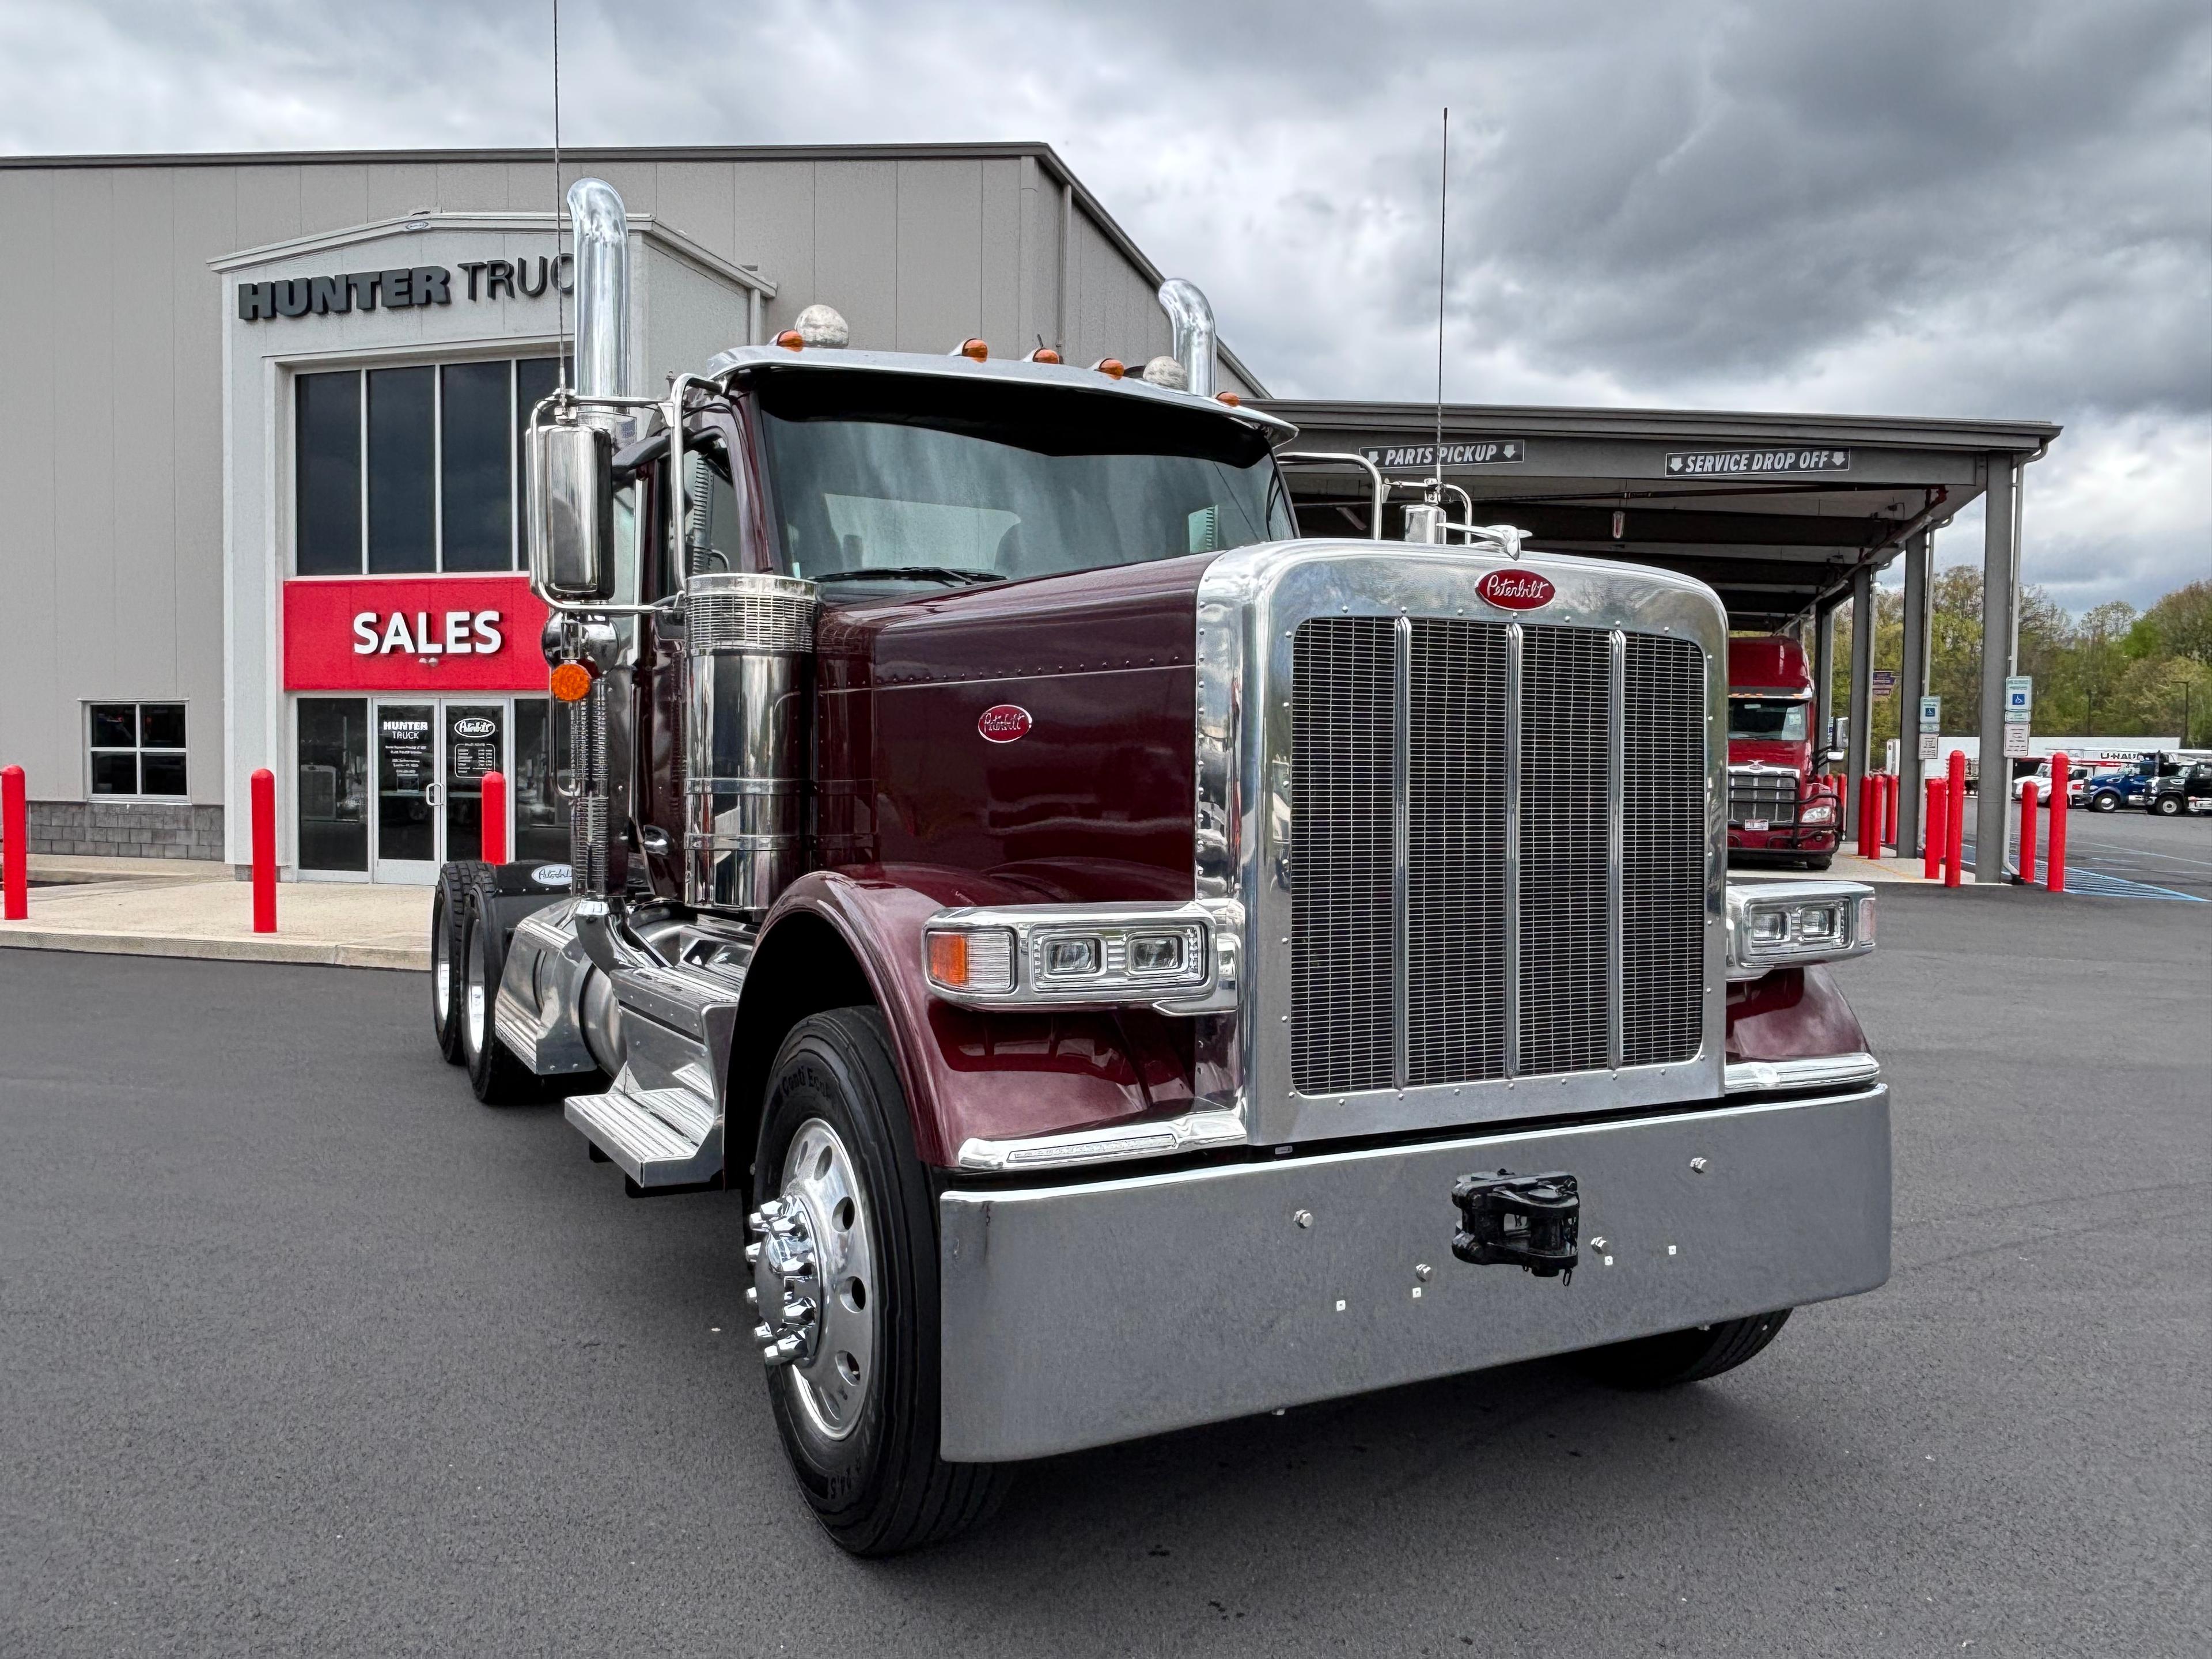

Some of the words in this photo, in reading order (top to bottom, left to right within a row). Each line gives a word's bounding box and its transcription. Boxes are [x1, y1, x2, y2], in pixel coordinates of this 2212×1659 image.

[238, 266, 451, 320] HUNTER
[457, 252, 574, 301] TRUC
[1385, 447, 1434, 465] PARTS
[1439, 444, 1497, 463] PICKUP
[1685, 453, 1749, 473] SERVICE
[1751, 452, 1796, 471] DROP
[1799, 450, 1830, 469] OFF
[1486, 574, 1549, 599] Peterbilt
[353, 611, 502, 654] SALES
[383, 721, 428, 730] HUNTER
[392, 731, 419, 740] TRUCK
